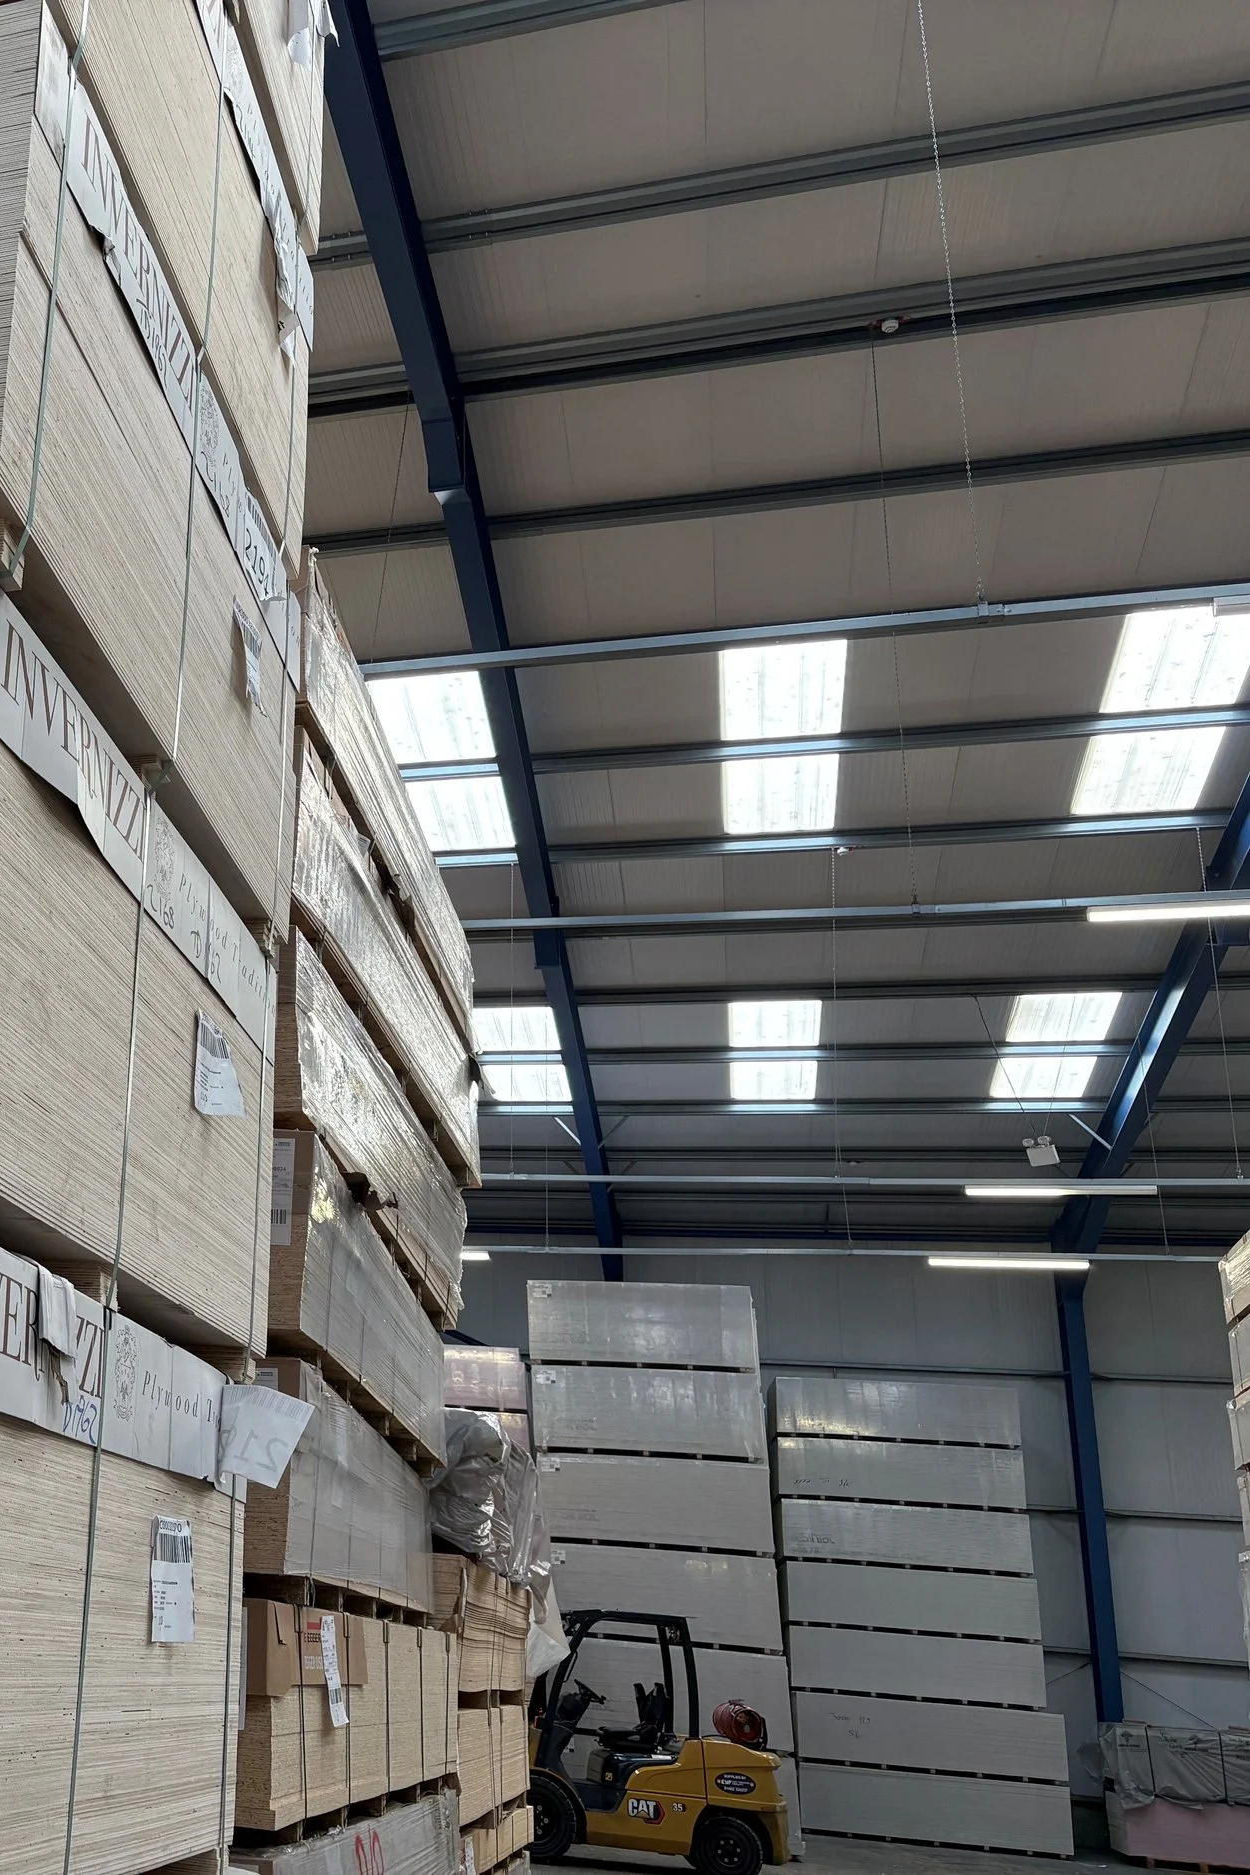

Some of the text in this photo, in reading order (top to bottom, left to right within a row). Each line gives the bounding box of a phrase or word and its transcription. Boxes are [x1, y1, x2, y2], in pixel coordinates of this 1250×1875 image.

[81, 109, 195, 417] INVERNIZZI
[0, 618, 147, 866] INVERNIZZI
[147, 884, 174, 930] 2168
[142, 1370, 200, 1418] Plywood
[628, 1799, 683, 1819] CAT 35
